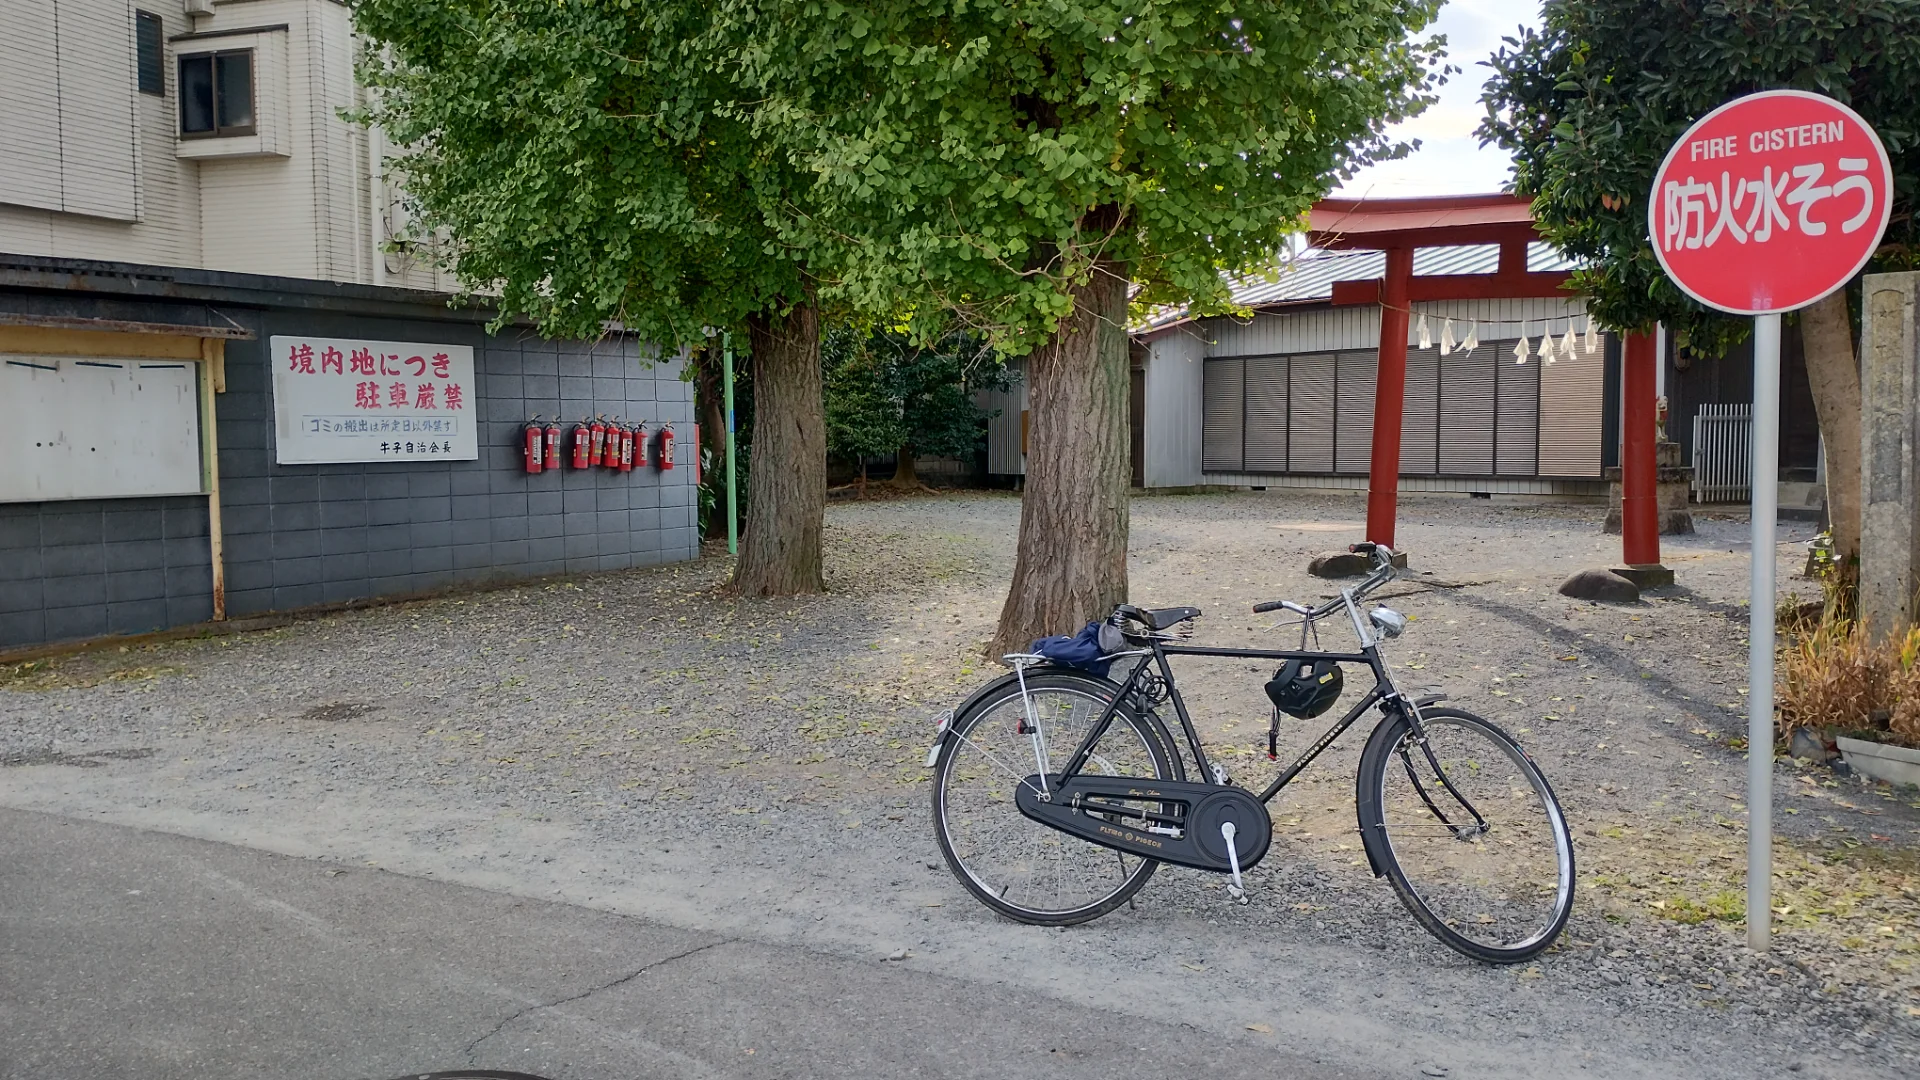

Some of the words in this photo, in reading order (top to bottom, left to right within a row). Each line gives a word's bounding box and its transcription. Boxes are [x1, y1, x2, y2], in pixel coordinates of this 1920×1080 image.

[1691, 136, 1737, 162] FIRE
[1749, 120, 1844, 154] CISTERN
[1664, 157, 1874, 252] 防火水そう
[289, 343, 451, 379] 境内地につき
[354, 381, 463, 410] 駐車厳禁
